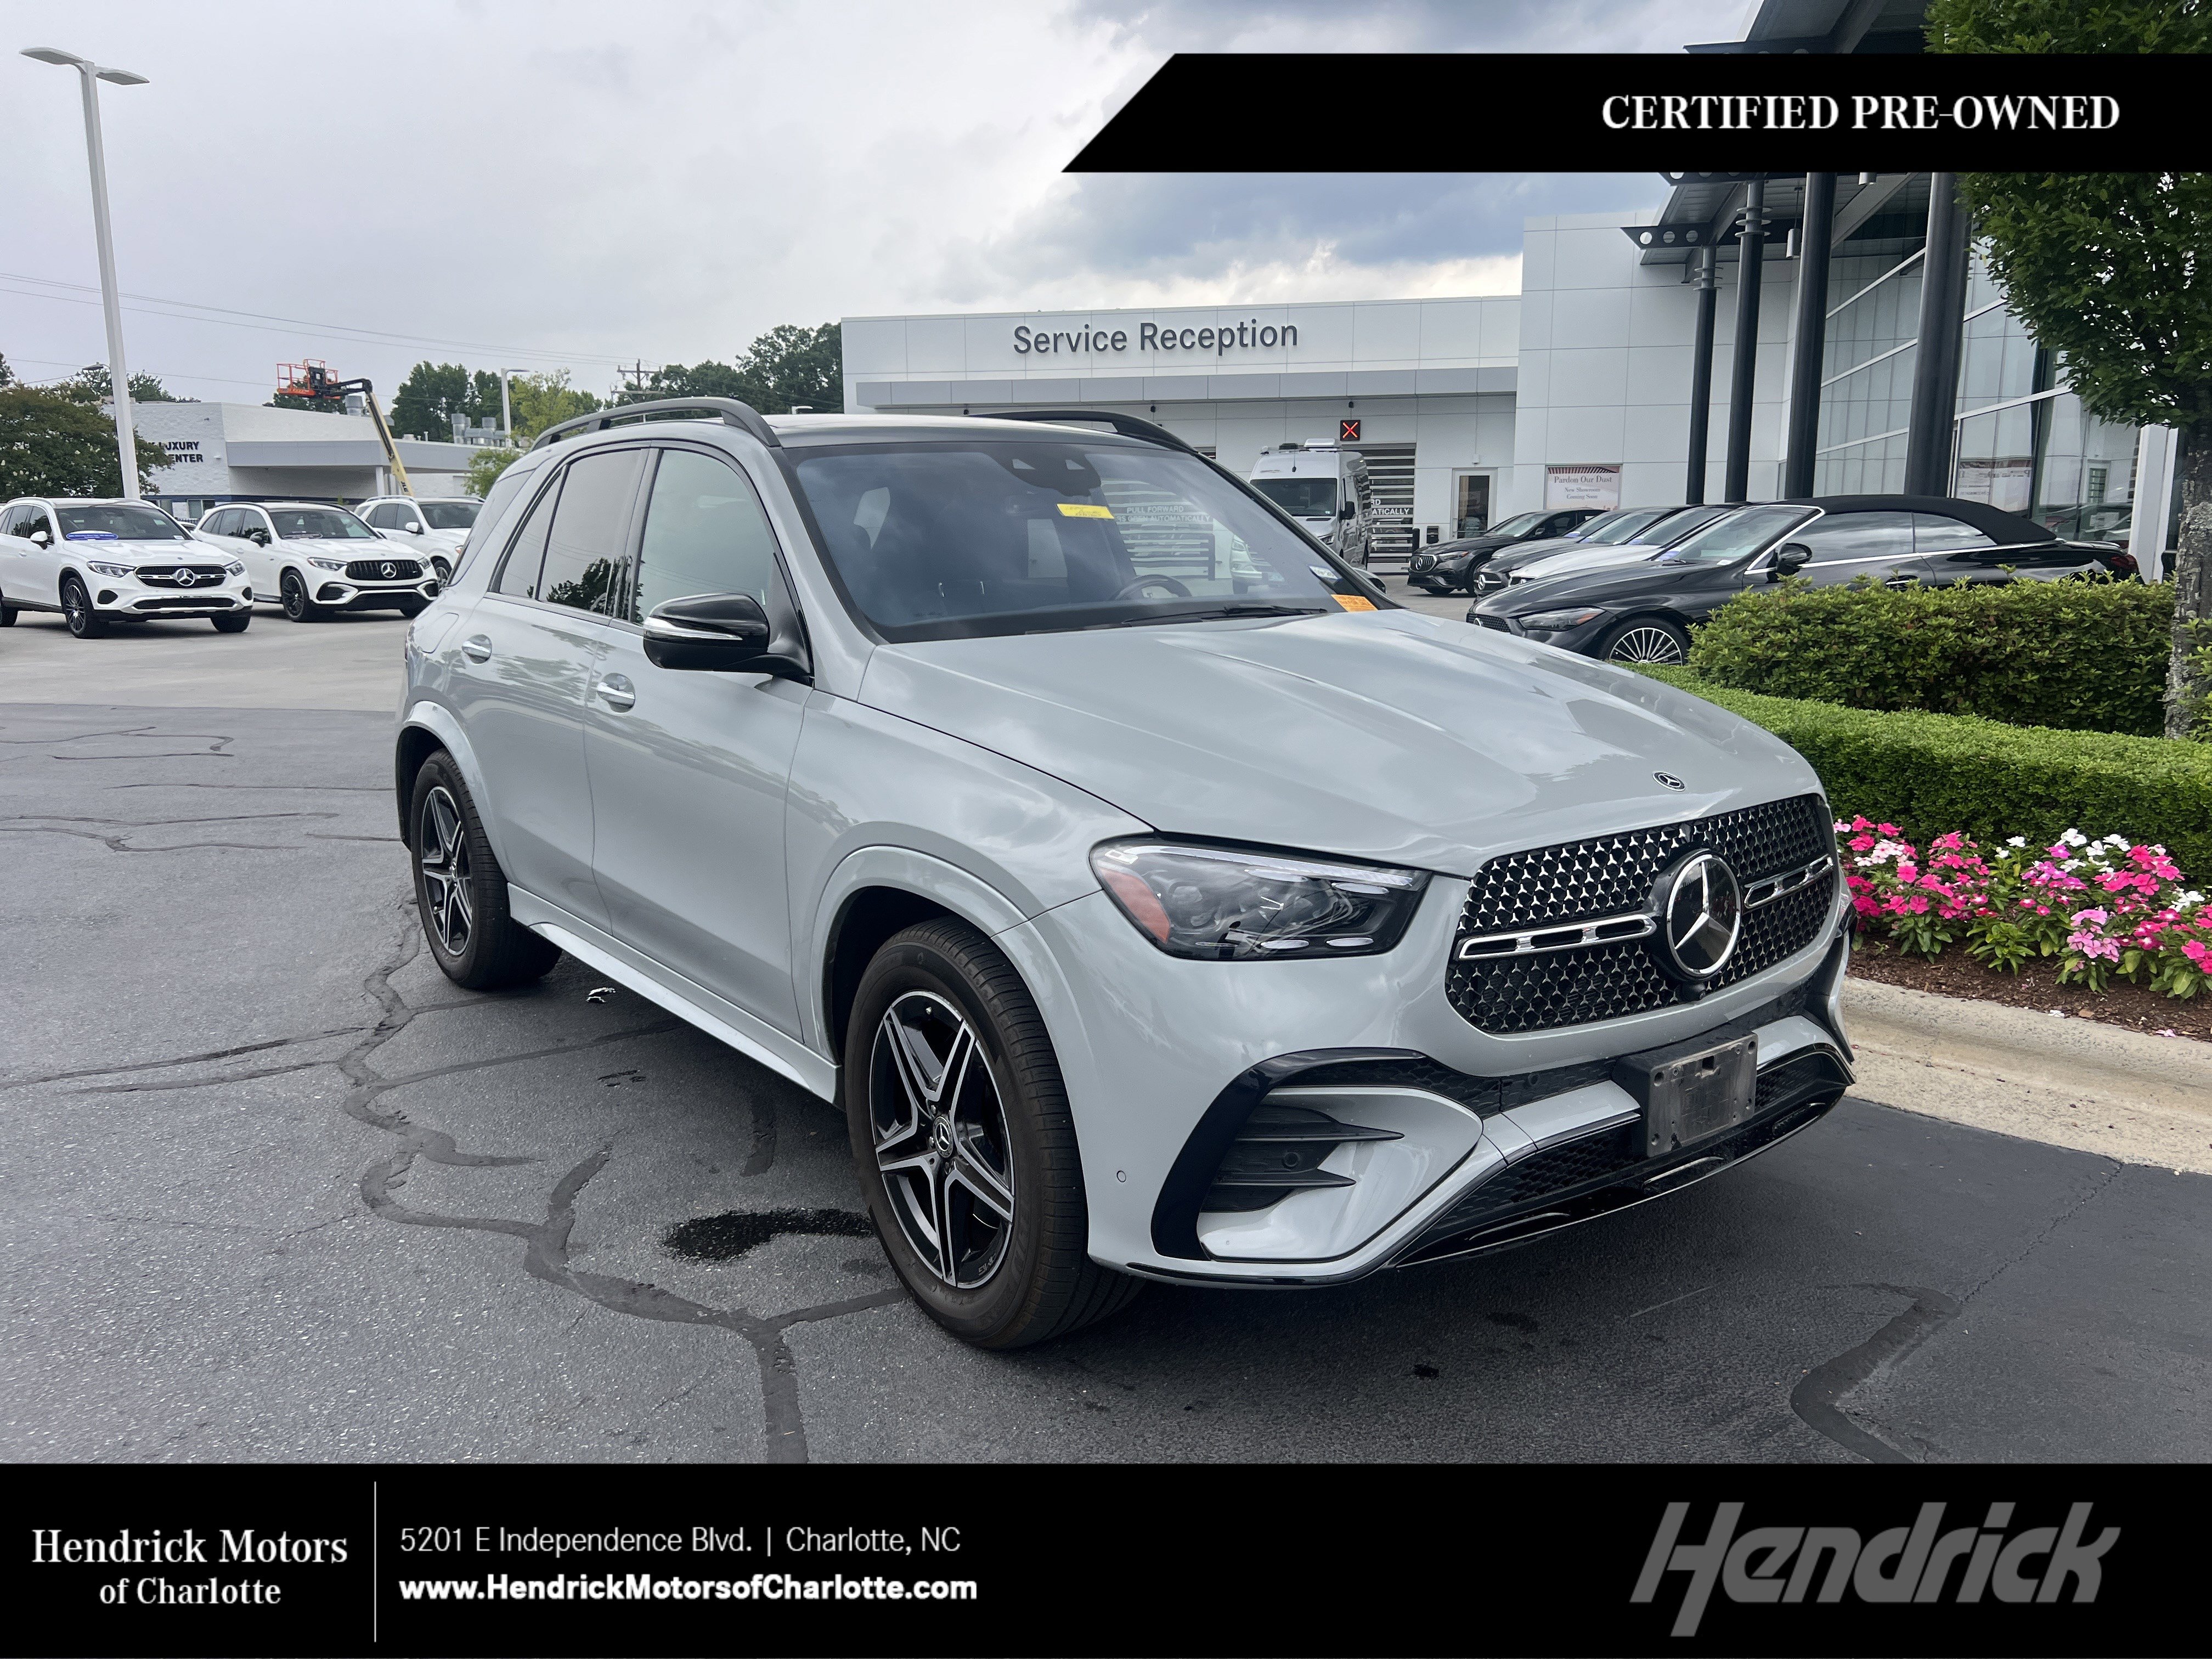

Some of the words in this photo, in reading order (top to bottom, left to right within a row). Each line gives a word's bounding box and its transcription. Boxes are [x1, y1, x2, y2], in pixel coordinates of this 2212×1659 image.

[1013, 324, 1127, 354] Service
[1139, 318, 1297, 356] Reception
[165, 454, 203, 462] ENTER
[1581, 475, 1594, 483] Our
